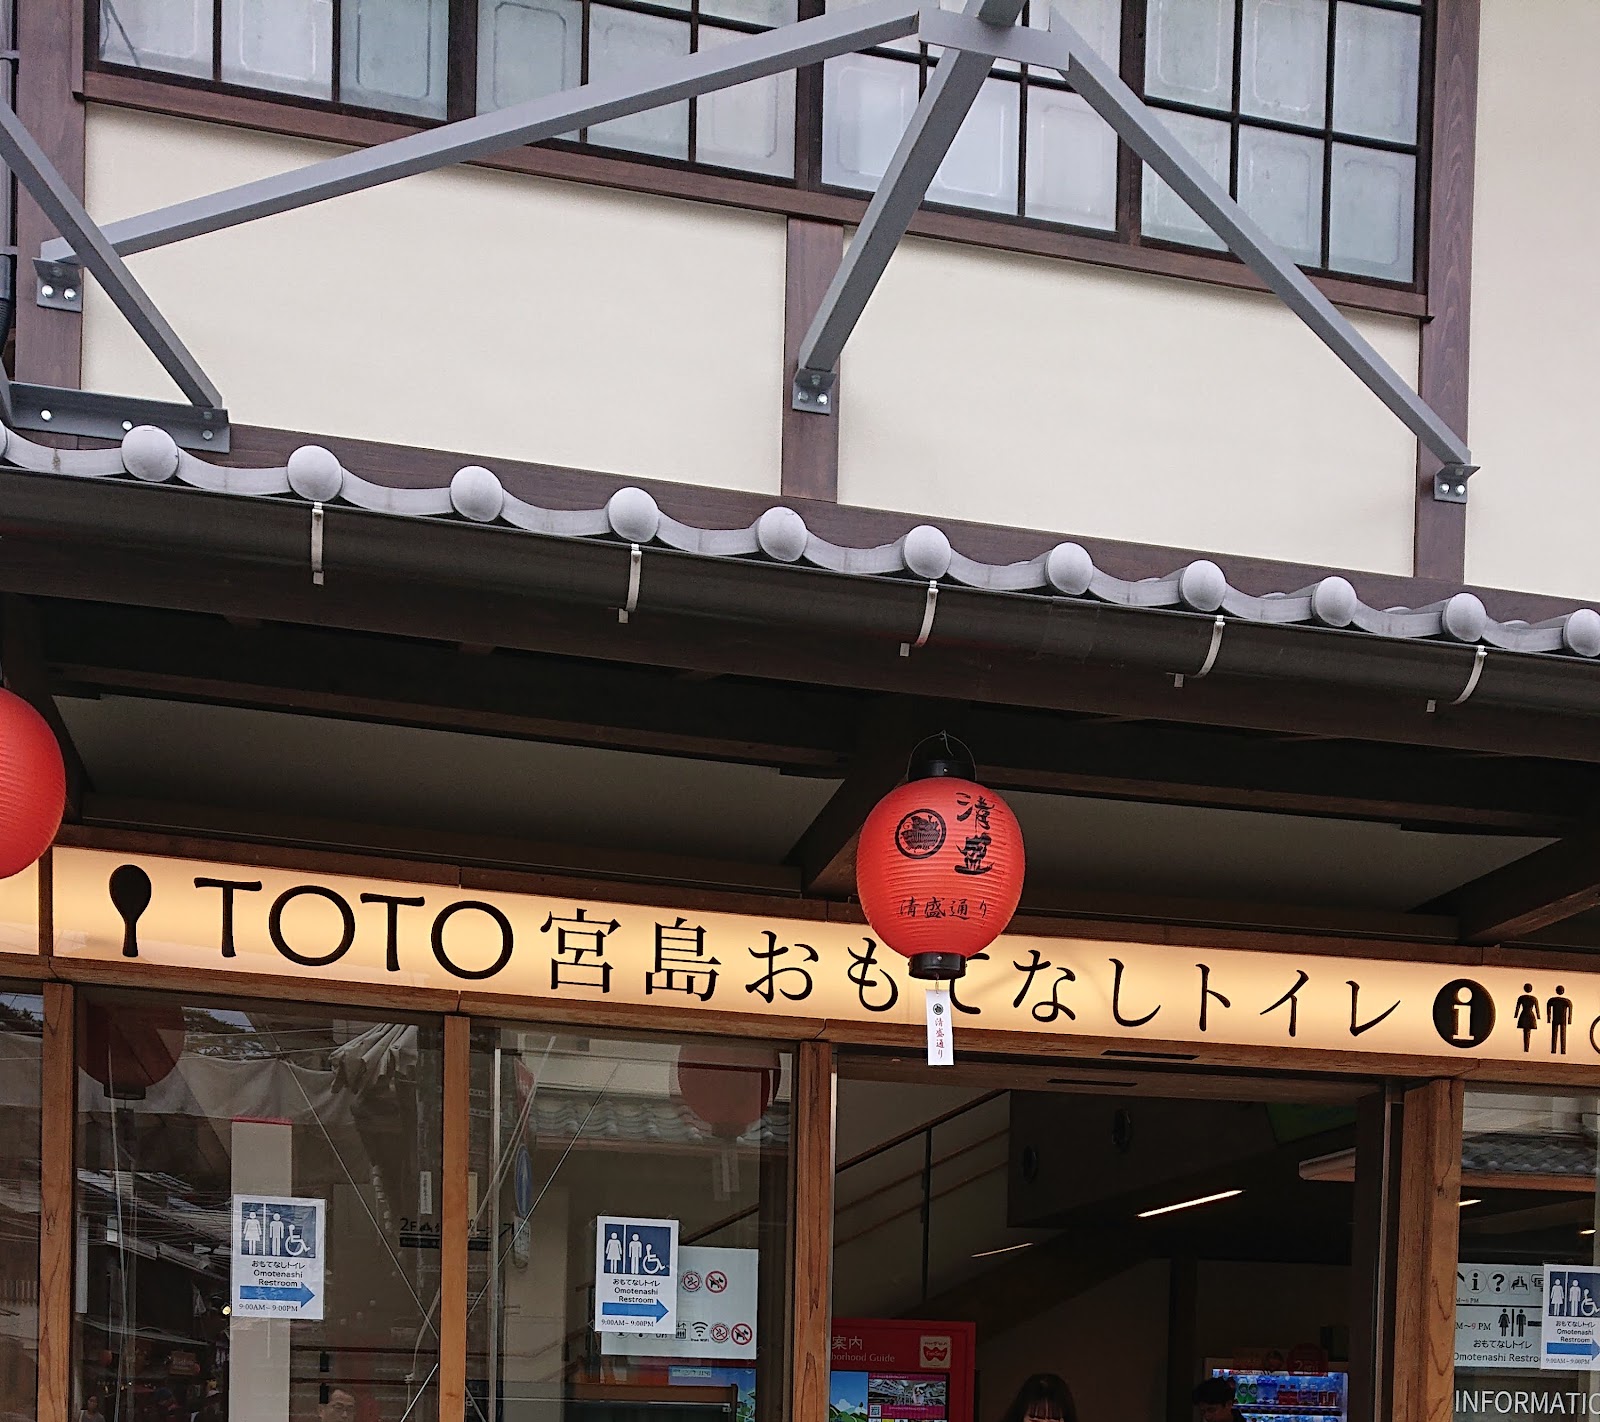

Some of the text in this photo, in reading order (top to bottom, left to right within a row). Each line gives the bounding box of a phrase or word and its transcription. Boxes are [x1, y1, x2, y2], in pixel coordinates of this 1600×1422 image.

[900, 896, 987, 920] 清盛通り
[251, 1260, 306, 1270] おもてなしトイレ
[253, 1269, 303, 1279] Omotenashi
[258, 1279, 298, 1287] Restroom
[612, 1278, 661, 1287] おもてなしトイレ
[614, 1287, 659, 1295] Omotenashi
[618, 1295, 654, 1304] Restroom
[1478, 1322, 1491, 1331] PM
[1555, 1320, 1596, 1328] おもてなしトイレ
[1556, 1328, 1594, 1336] Omotenashi
[1473, 1340, 1533, 1350] おもてなしトイレ
[869, 1353, 895, 1363] Guide
[1454, 1352, 1541, 1363] Omotenashi Restro
